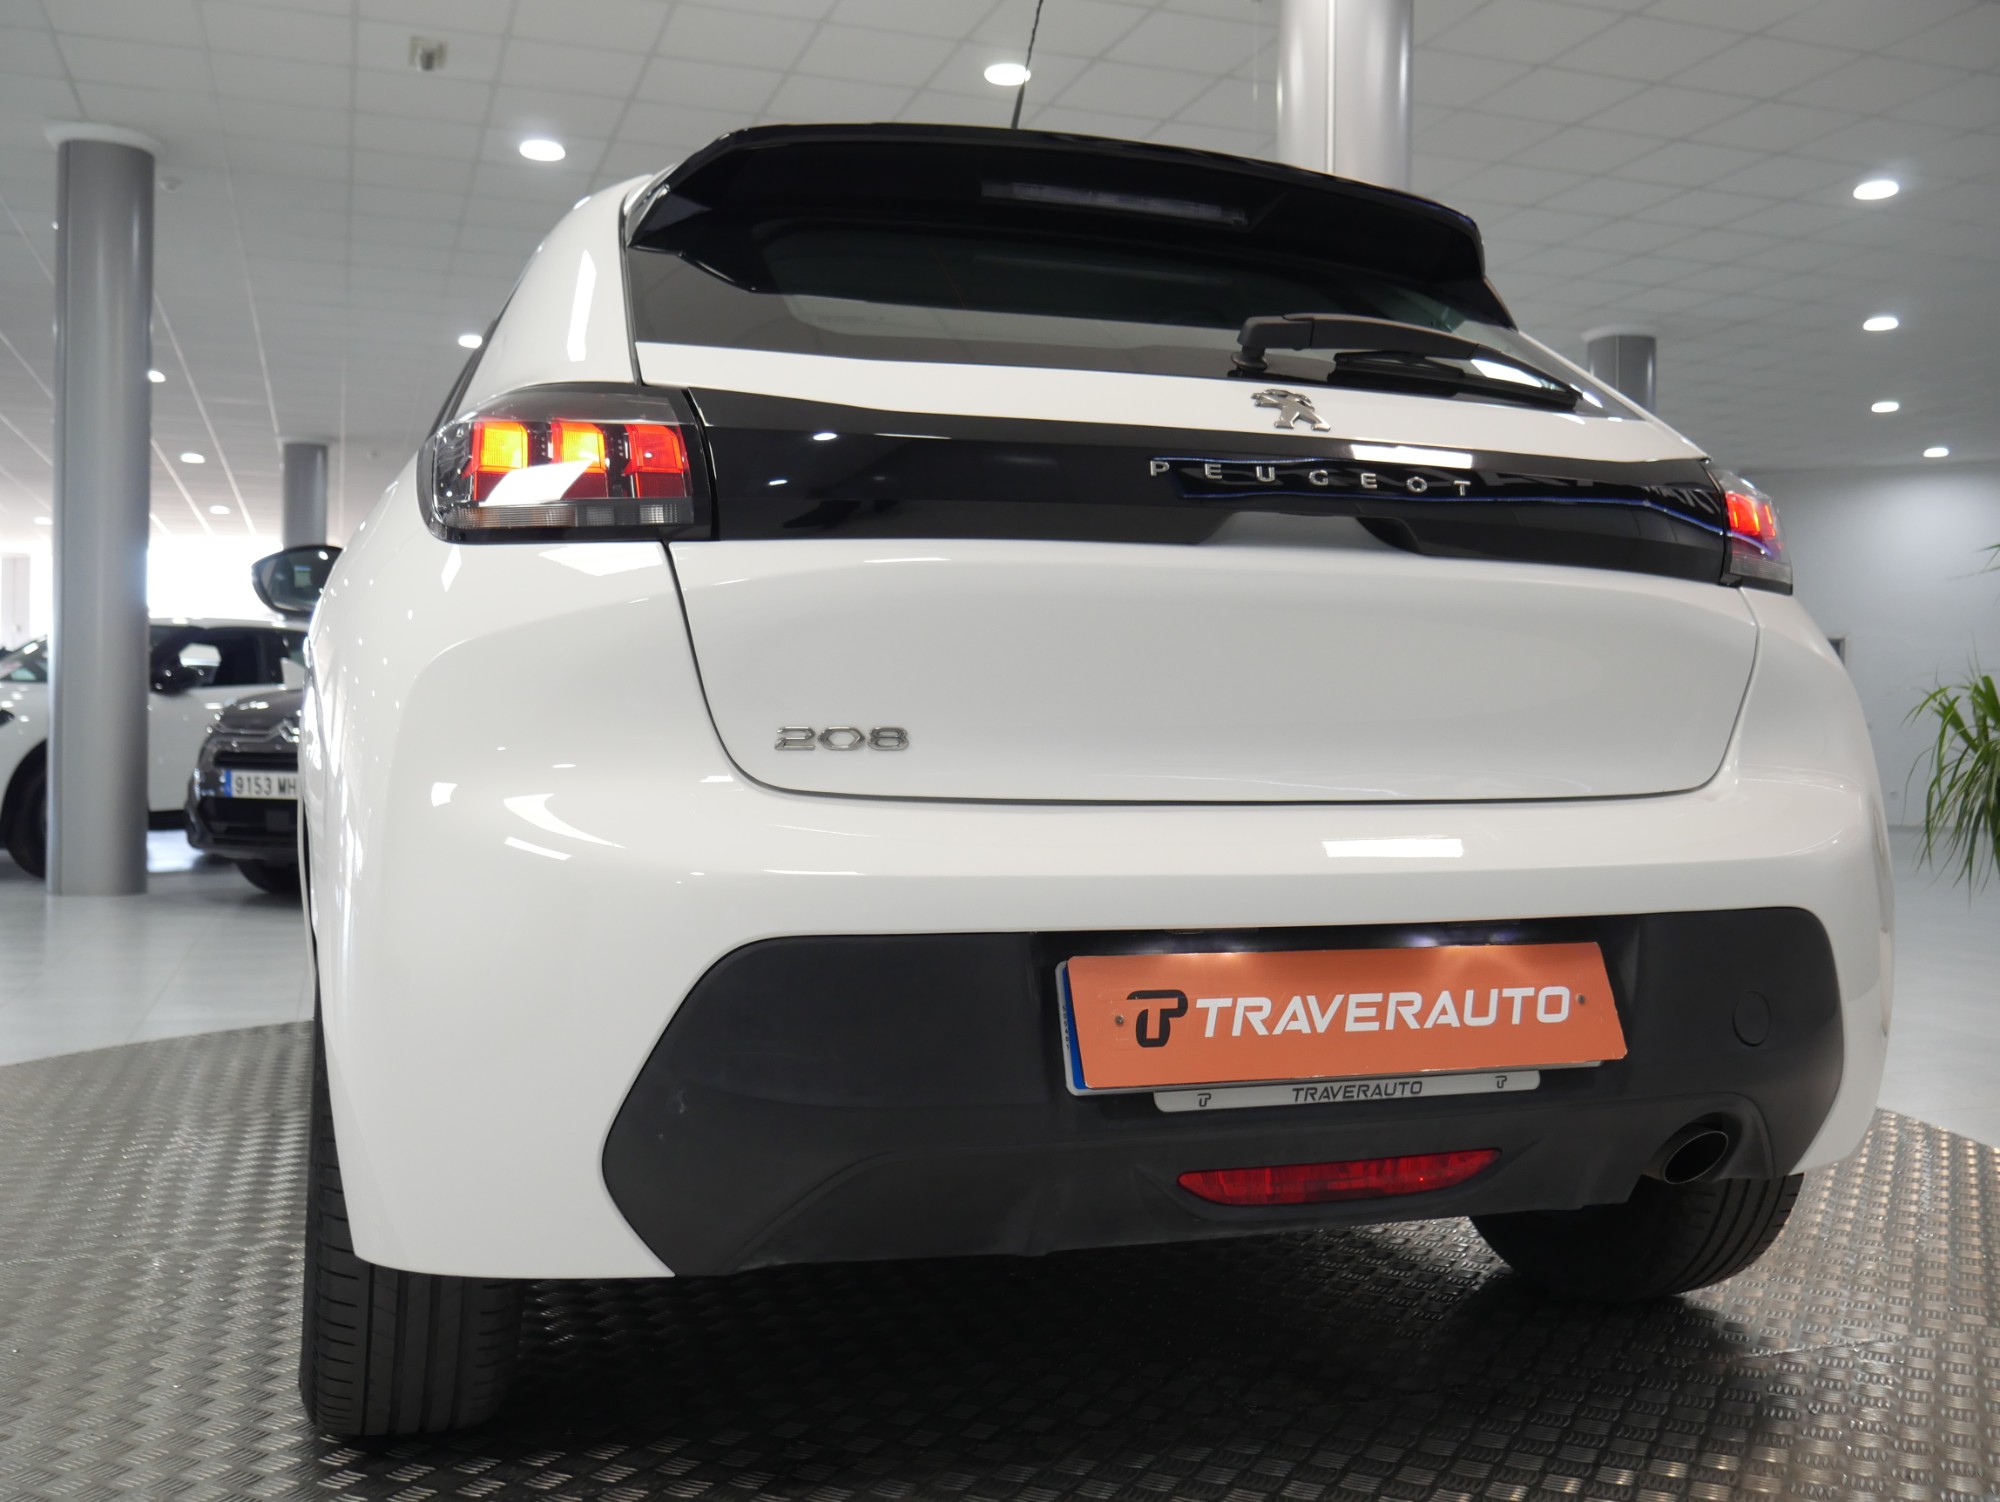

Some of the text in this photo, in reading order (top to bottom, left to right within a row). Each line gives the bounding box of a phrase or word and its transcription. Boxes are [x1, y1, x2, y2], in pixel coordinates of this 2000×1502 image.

[1150, 460, 1471, 496] PEUGEOT
[775, 726, 910, 751] 208
[235, 775, 272, 796] 9153
[1196, 986, 1570, 1038] TRAVERAUTO
[1292, 1081, 1423, 1102] TRAVERAUTO
